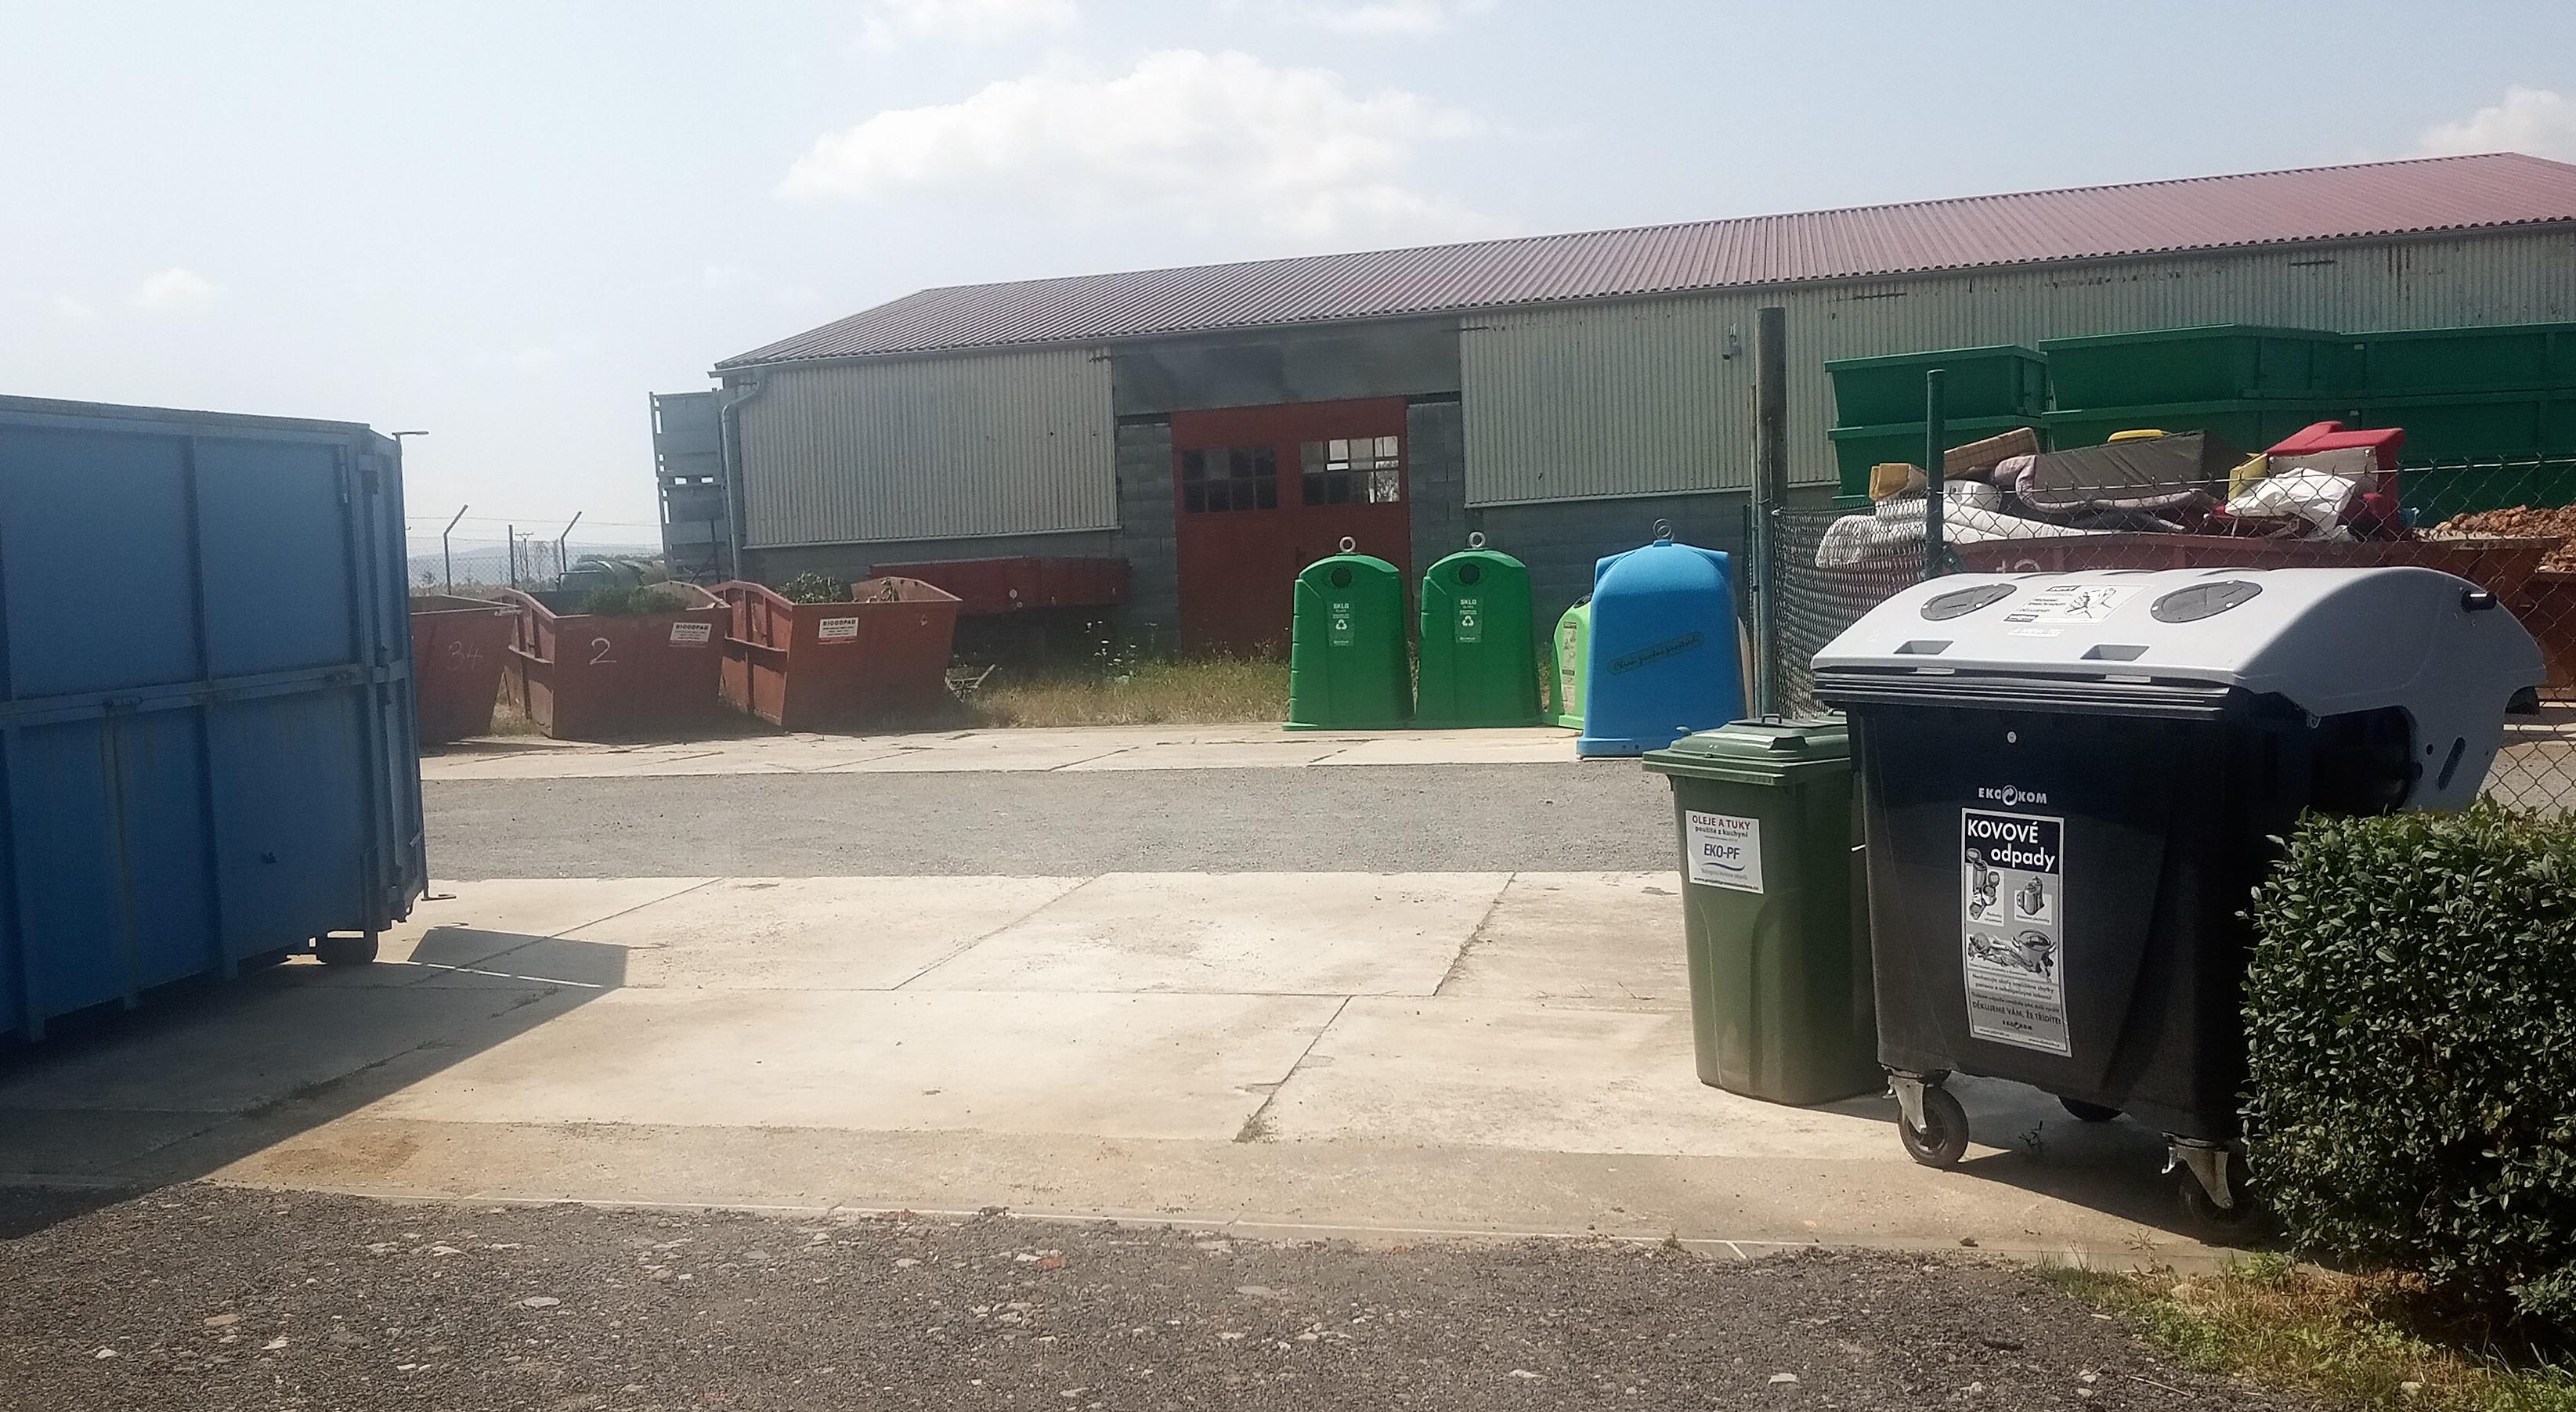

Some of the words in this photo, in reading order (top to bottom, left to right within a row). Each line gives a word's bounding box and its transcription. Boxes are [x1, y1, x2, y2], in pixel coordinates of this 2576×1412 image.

[446, 640, 483, 671] 34
[589, 637, 617, 666] 2
[1692, 814, 1716, 826] OLEJE
[1718, 818, 1725, 828] A
[1725, 819, 1750, 830] TUKY
[1967, 819, 2039, 843] KOVOVÉ
[1722, 828, 1748, 838] kuchyní
[1703, 843, 1740, 860] EKO-PF
[1990, 843, 2056, 872] odpady
[1972, 1001, 2005, 1015] DĚKUJEME
[2025, 1009, 2036, 1020] ŽE
